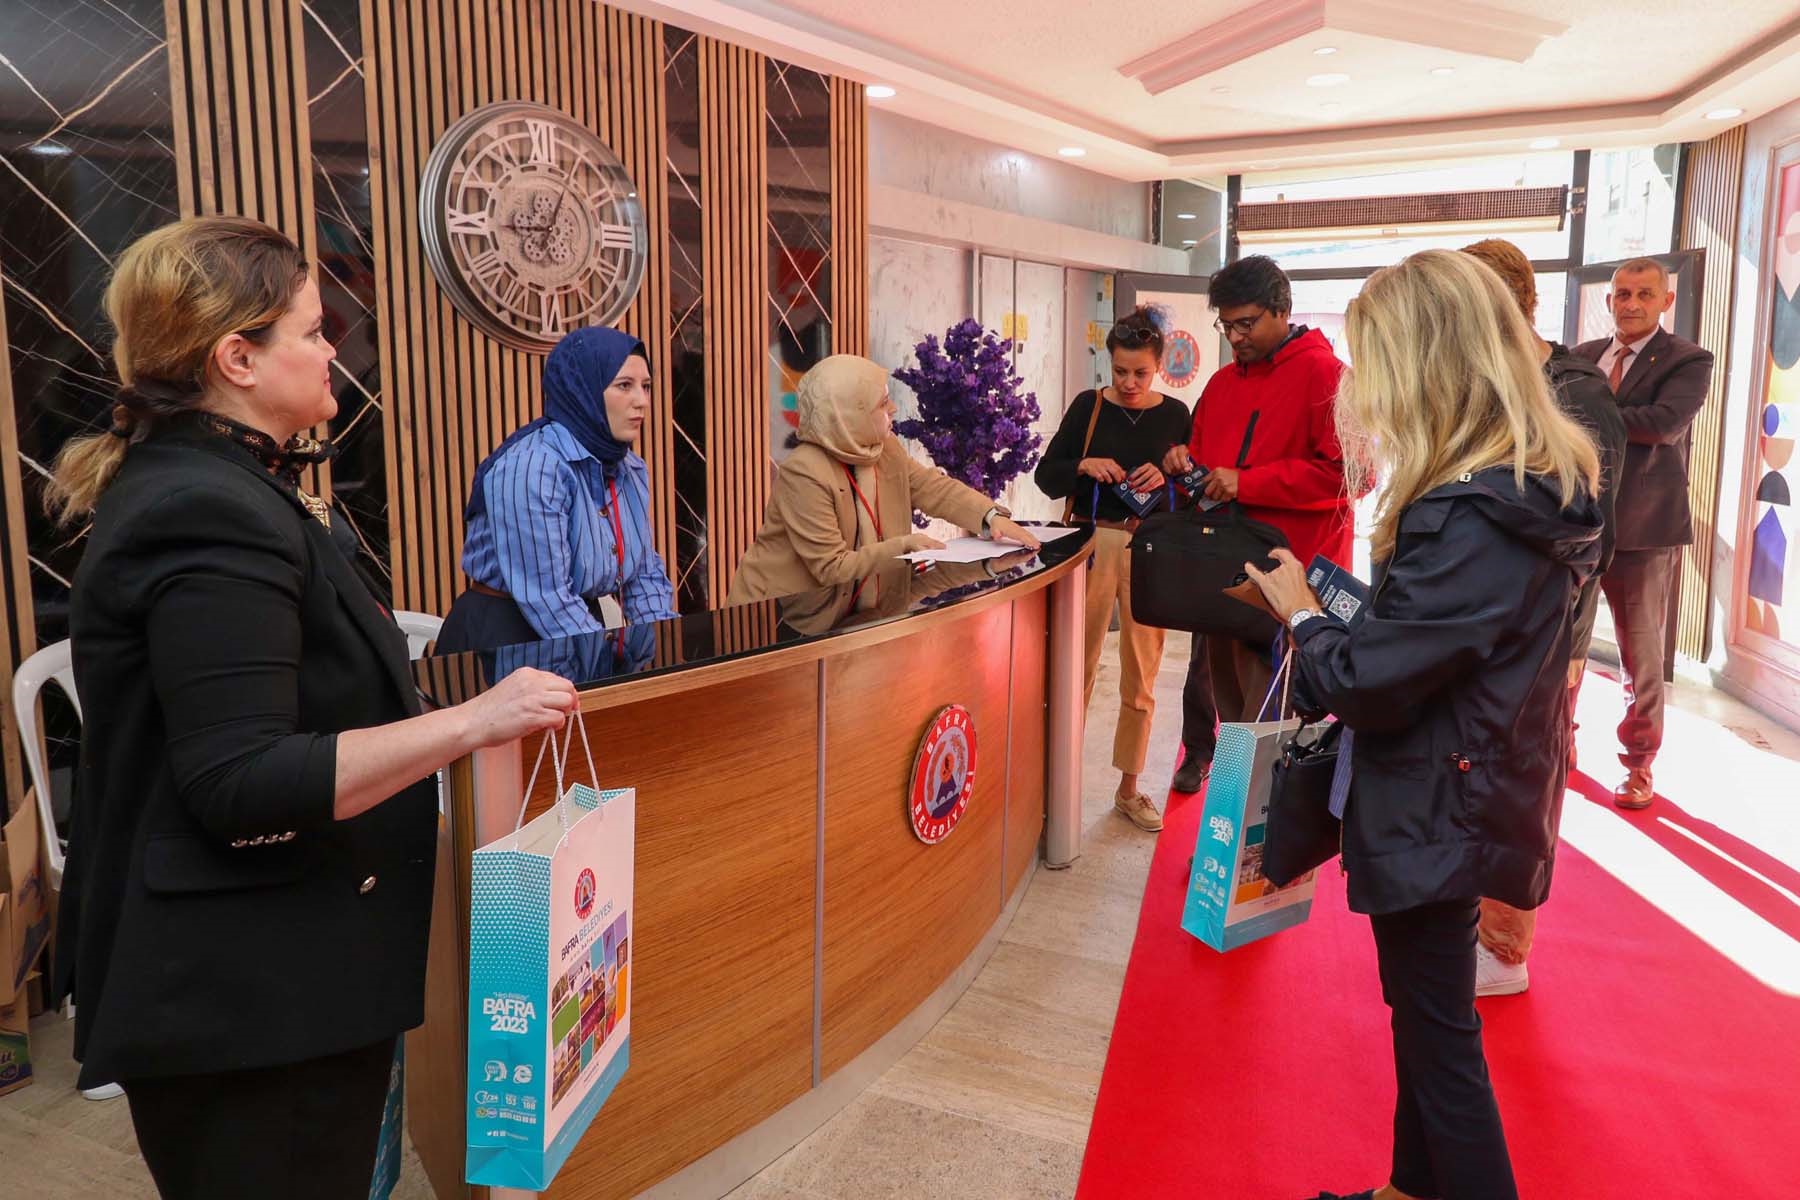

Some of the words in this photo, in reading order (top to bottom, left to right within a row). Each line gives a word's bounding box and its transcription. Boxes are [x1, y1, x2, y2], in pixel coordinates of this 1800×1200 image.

[525, 118, 557, 168] XII
[448, 207, 489, 236] IX
[600, 222, 635, 250] III
[927, 714, 967, 754] BAFRA
[561, 934, 579, 961] BAFRA
[483, 998, 536, 1020] BAFRA
[491, 1014, 528, 1034] 2023
